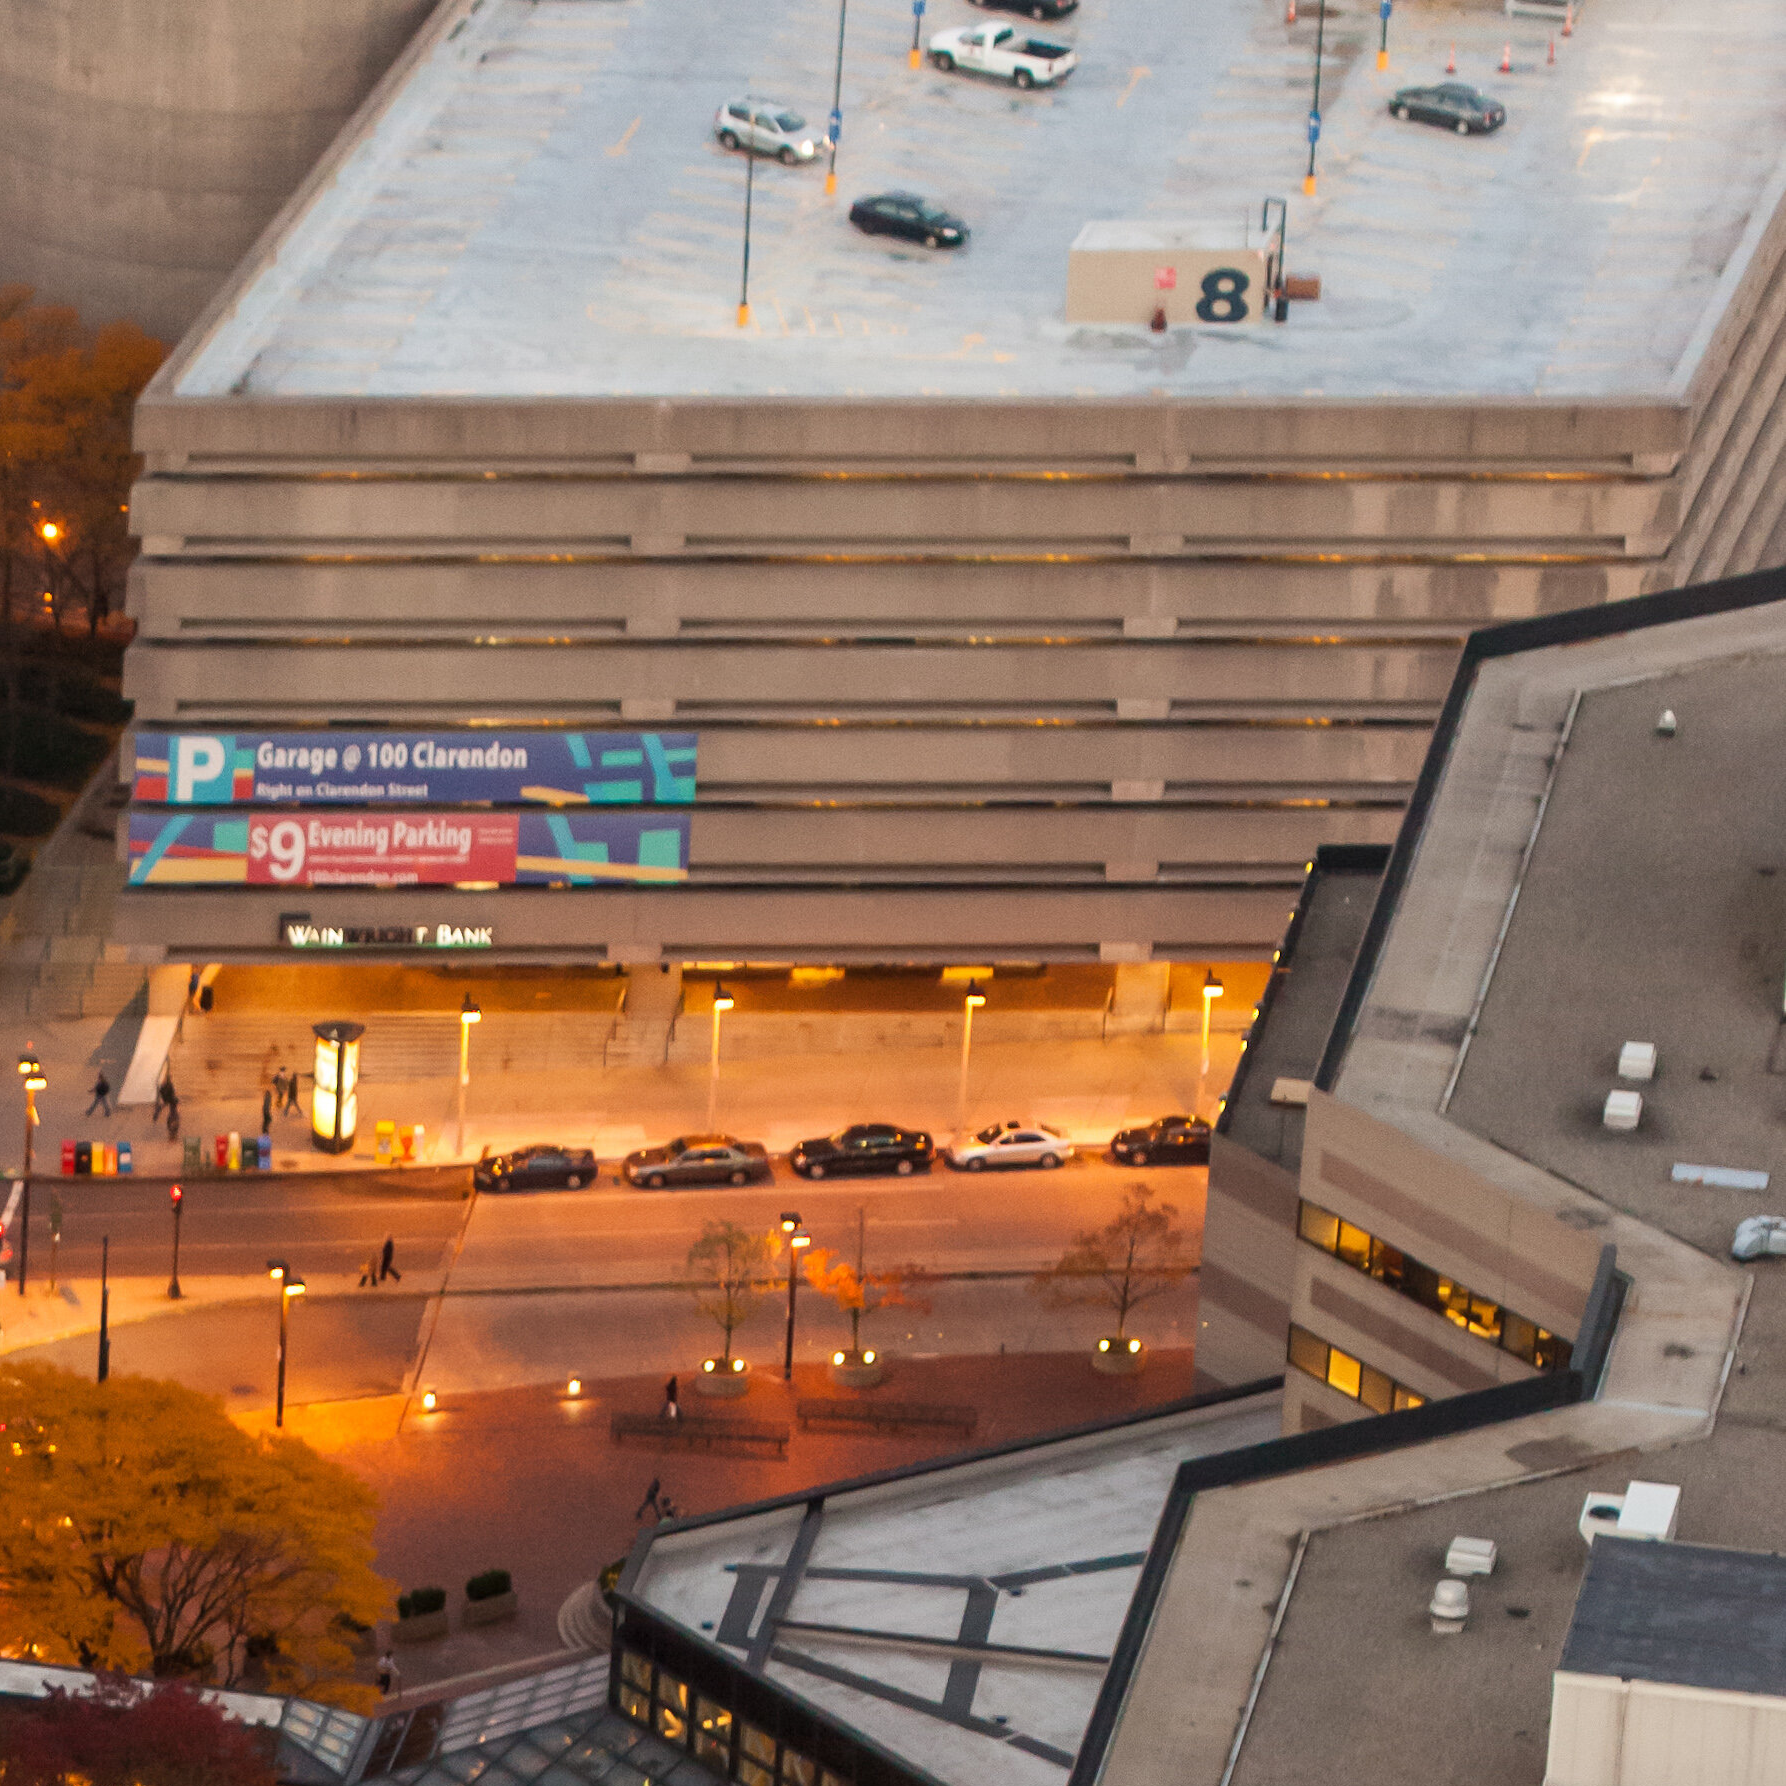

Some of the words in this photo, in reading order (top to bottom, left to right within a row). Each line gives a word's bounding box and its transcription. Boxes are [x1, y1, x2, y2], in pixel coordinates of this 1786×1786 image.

[1196, 268, 1250, 322] 8
[176, 736, 226, 802] P
[257, 741, 338, 776] Garage
[342, 744, 362, 773] @
[367, 742, 408, 768] 100
[413, 740, 528, 769] Clarendon
[256, 782, 293, 800] Right
[295, 785, 313, 797] on
[315, 782, 385, 798] Clarendon
[388, 782, 428, 797] Street
[250, 820, 306, 881] $9
[308, 820, 389, 855] Evening
[393, 820, 472, 855] Parking
[436, 924, 493, 946] BANK
